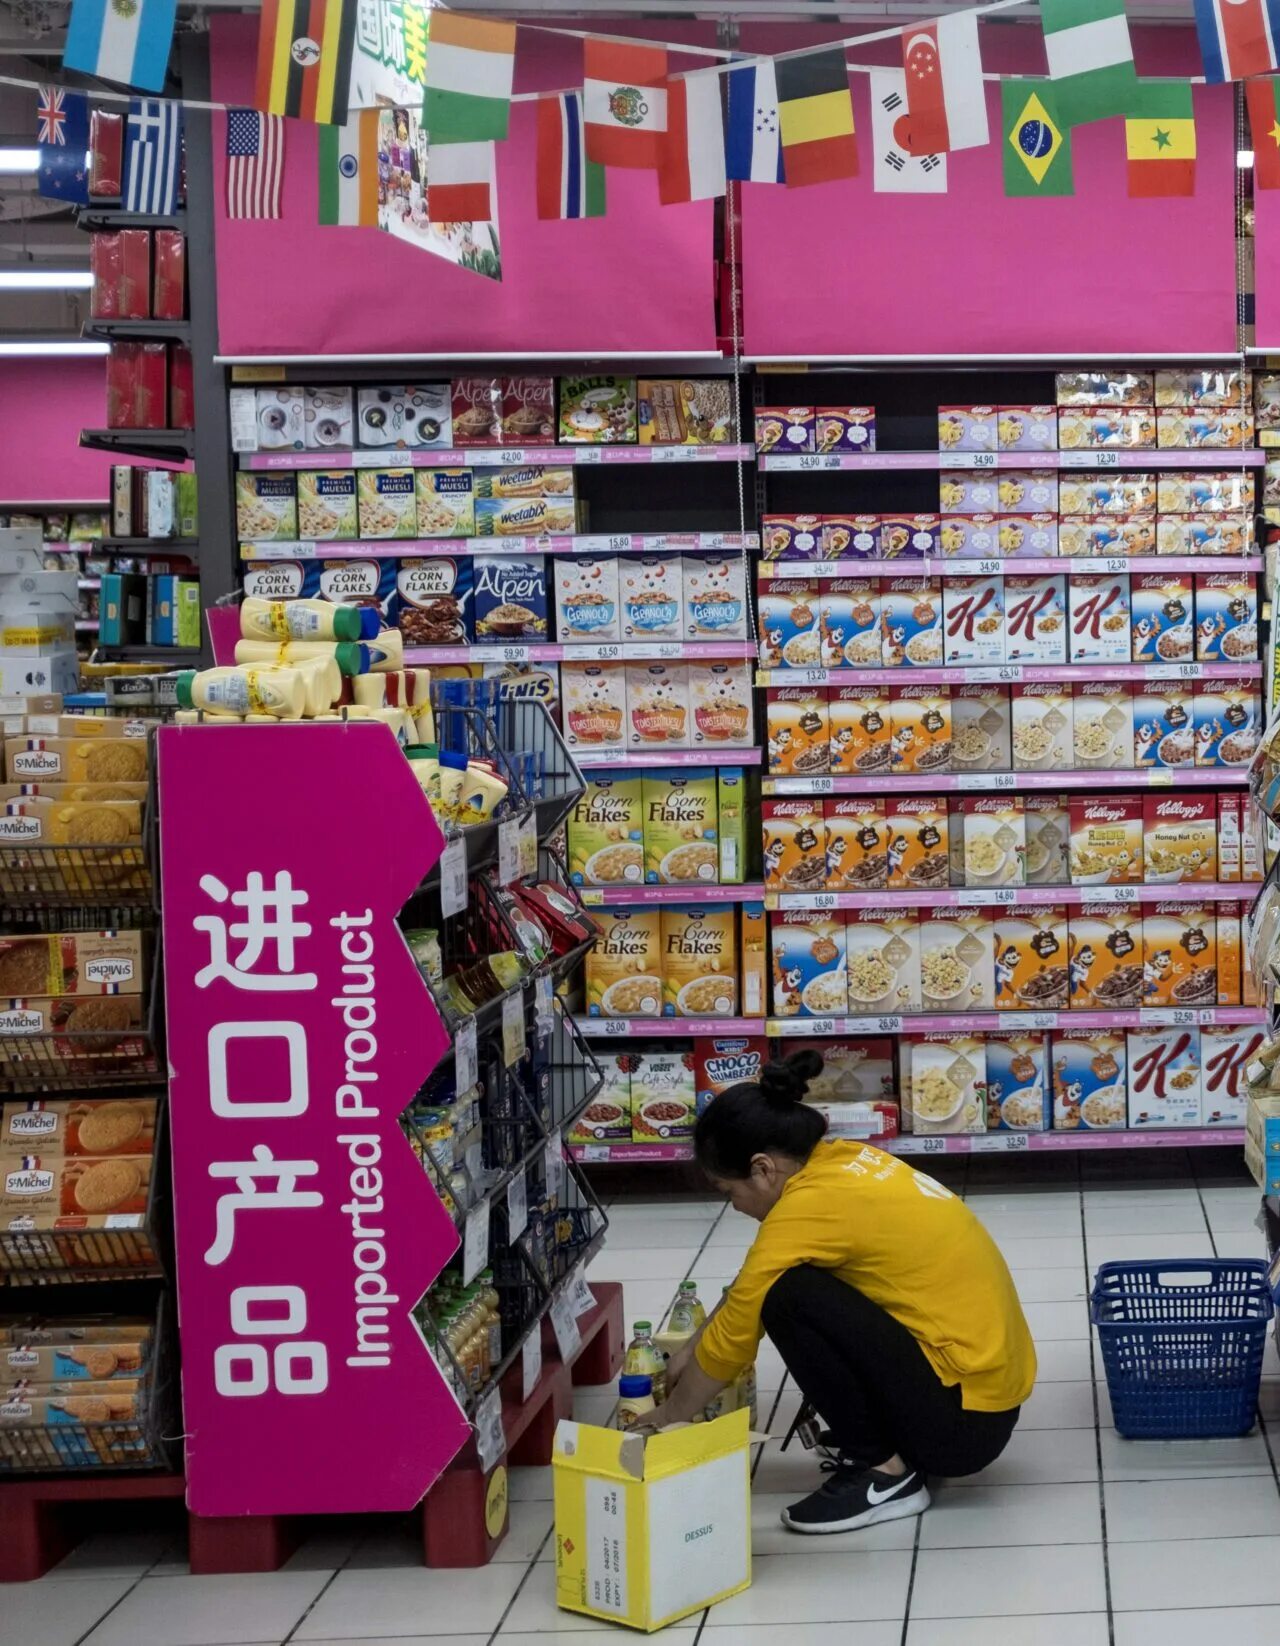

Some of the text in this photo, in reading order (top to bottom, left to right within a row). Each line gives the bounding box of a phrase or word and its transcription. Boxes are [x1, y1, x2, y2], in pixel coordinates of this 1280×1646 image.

[568, 376, 616, 398] BALLS
[501, 452, 522, 462] 42.00
[800, 456, 820, 466] 34.90
[973, 455, 994, 465] 34.90
[1096, 453, 1116, 463] 12.30
[501, 503, 546, 524] Weetabix
[609, 537, 629, 547] 15.80
[979, 562, 1000, 571] 34.90
[1107, 560, 1127, 570] 12.30
[257, 575, 290, 585] CORN
[333, 573, 367, 583] CORN
[410, 572, 443, 582] CORN
[328, 583, 372, 593] FLAKES
[405, 581, 448, 592] FLAKES
[475, 565, 545, 602] Alpen
[252, 584, 296, 595] FLAKES
[946, 587, 996, 642] K
[1008, 586, 1057, 641] K
[1073, 585, 1122, 640] K
[504, 648, 525, 658] 59.90
[597, 647, 618, 656] 43.50
[806, 670, 827, 680] 13.20
[1179, 665, 1199, 675] 18.80
[811, 779, 831, 789] 16.80
[590, 788, 634, 808] Corn
[665, 788, 710, 807] Corn
[573, 802, 631, 823] Flakes
[648, 801, 705, 821] Flakes
[1156, 800, 1205, 816] Kellogg's
[1084, 806, 1126, 821] Kellogg's
[1155, 833, 1190, 842] Honey Nut
[995, 891, 1014, 901] 14.80
[1114, 888, 1135, 898] 24.90
[814, 895, 834, 906] 16.80
[609, 921, 651, 941] Corn
[683, 920, 725, 941] Corn
[591, 938, 648, 954] Flakes
[667, 934, 722, 955] Flakes
[1174, 1012, 1193, 1022] 32.50
[605, 1022, 626, 1032] 25.00
[813, 1021, 833, 1031] 26.90
[878, 1019, 899, 1029] 26.90
[706, 1053, 760, 1073] CHOCO
[1133, 1032, 1192, 1099] K
[710, 1066, 758, 1082] NUMBERZ
[193, 869, 329, 1398] 进口产品
[330, 907, 400, 1368] Imported Product
[923, 1139, 944, 1149] 23.20
[1006, 1136, 1026, 1146] 32.50
[684, 1522, 713, 1543] DESSUS
